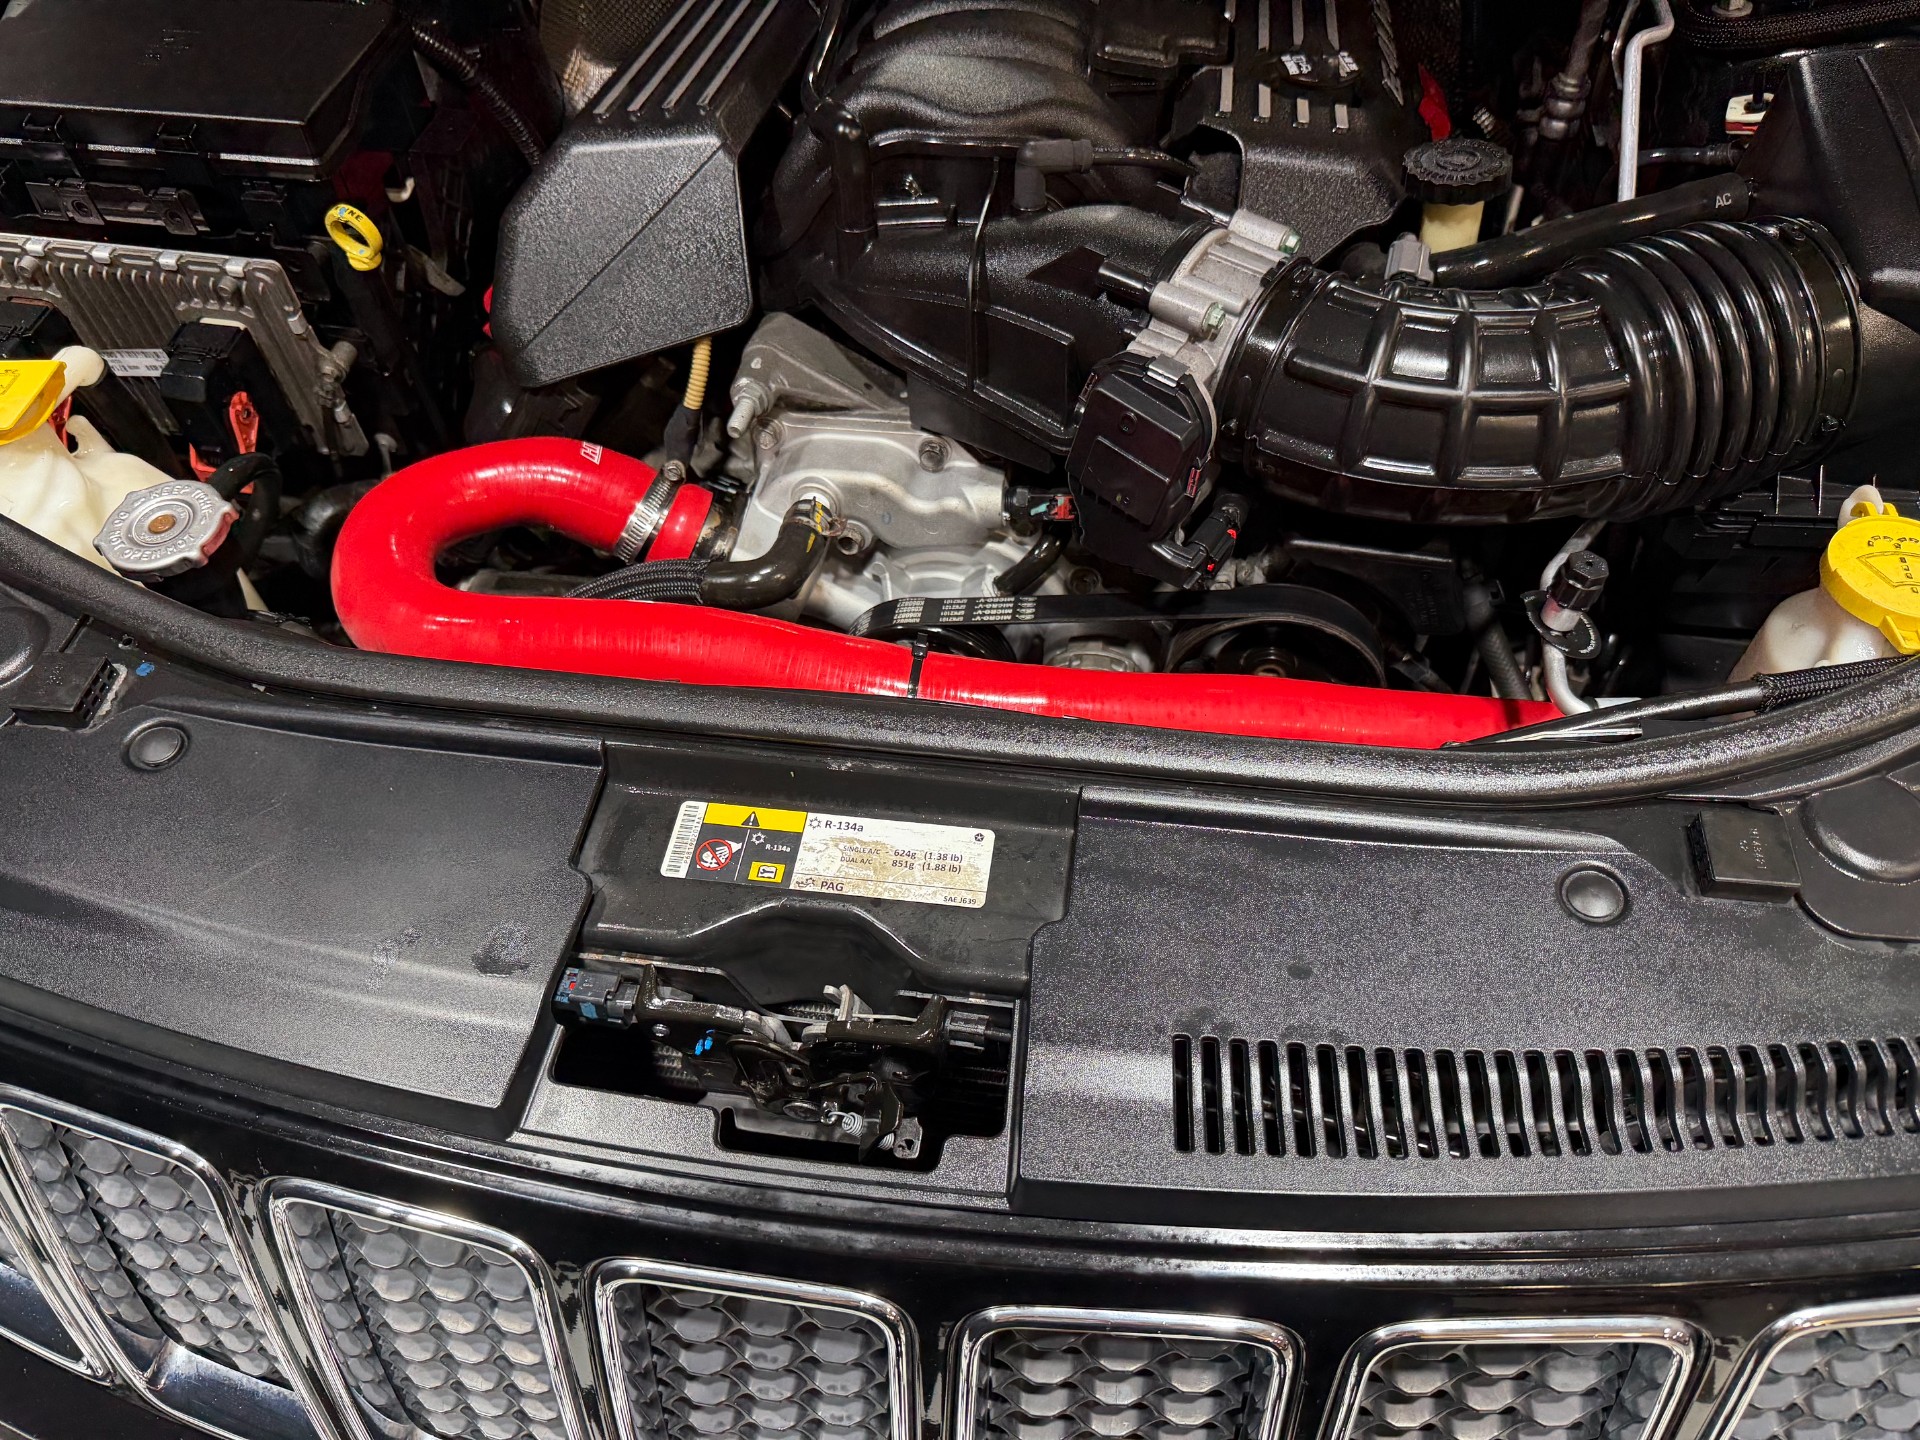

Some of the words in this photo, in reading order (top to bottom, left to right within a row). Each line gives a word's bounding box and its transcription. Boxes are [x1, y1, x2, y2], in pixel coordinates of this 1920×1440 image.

[1715, 193, 1731, 208] AC
[149, 485, 191, 500] KEEP
[112, 511, 130, 528] DO
[109, 530, 127, 551] NOT
[824, 819, 864, 832] R-134a
[765, 843, 791, 852] R-134a
[843, 845, 867, 854] SINGLE
[893, 849, 917, 860] 624g
[924, 851, 949, 861] (1.38
[950, 853, 963, 864] lb)
[891, 859, 915, 871] 851g
[922, 861, 947, 872] (1.88
[948, 864, 962, 875] lb)
[820, 880, 845, 892] PAG
[943, 895, 958, 903] SAE
[959, 897, 977, 905] J639
